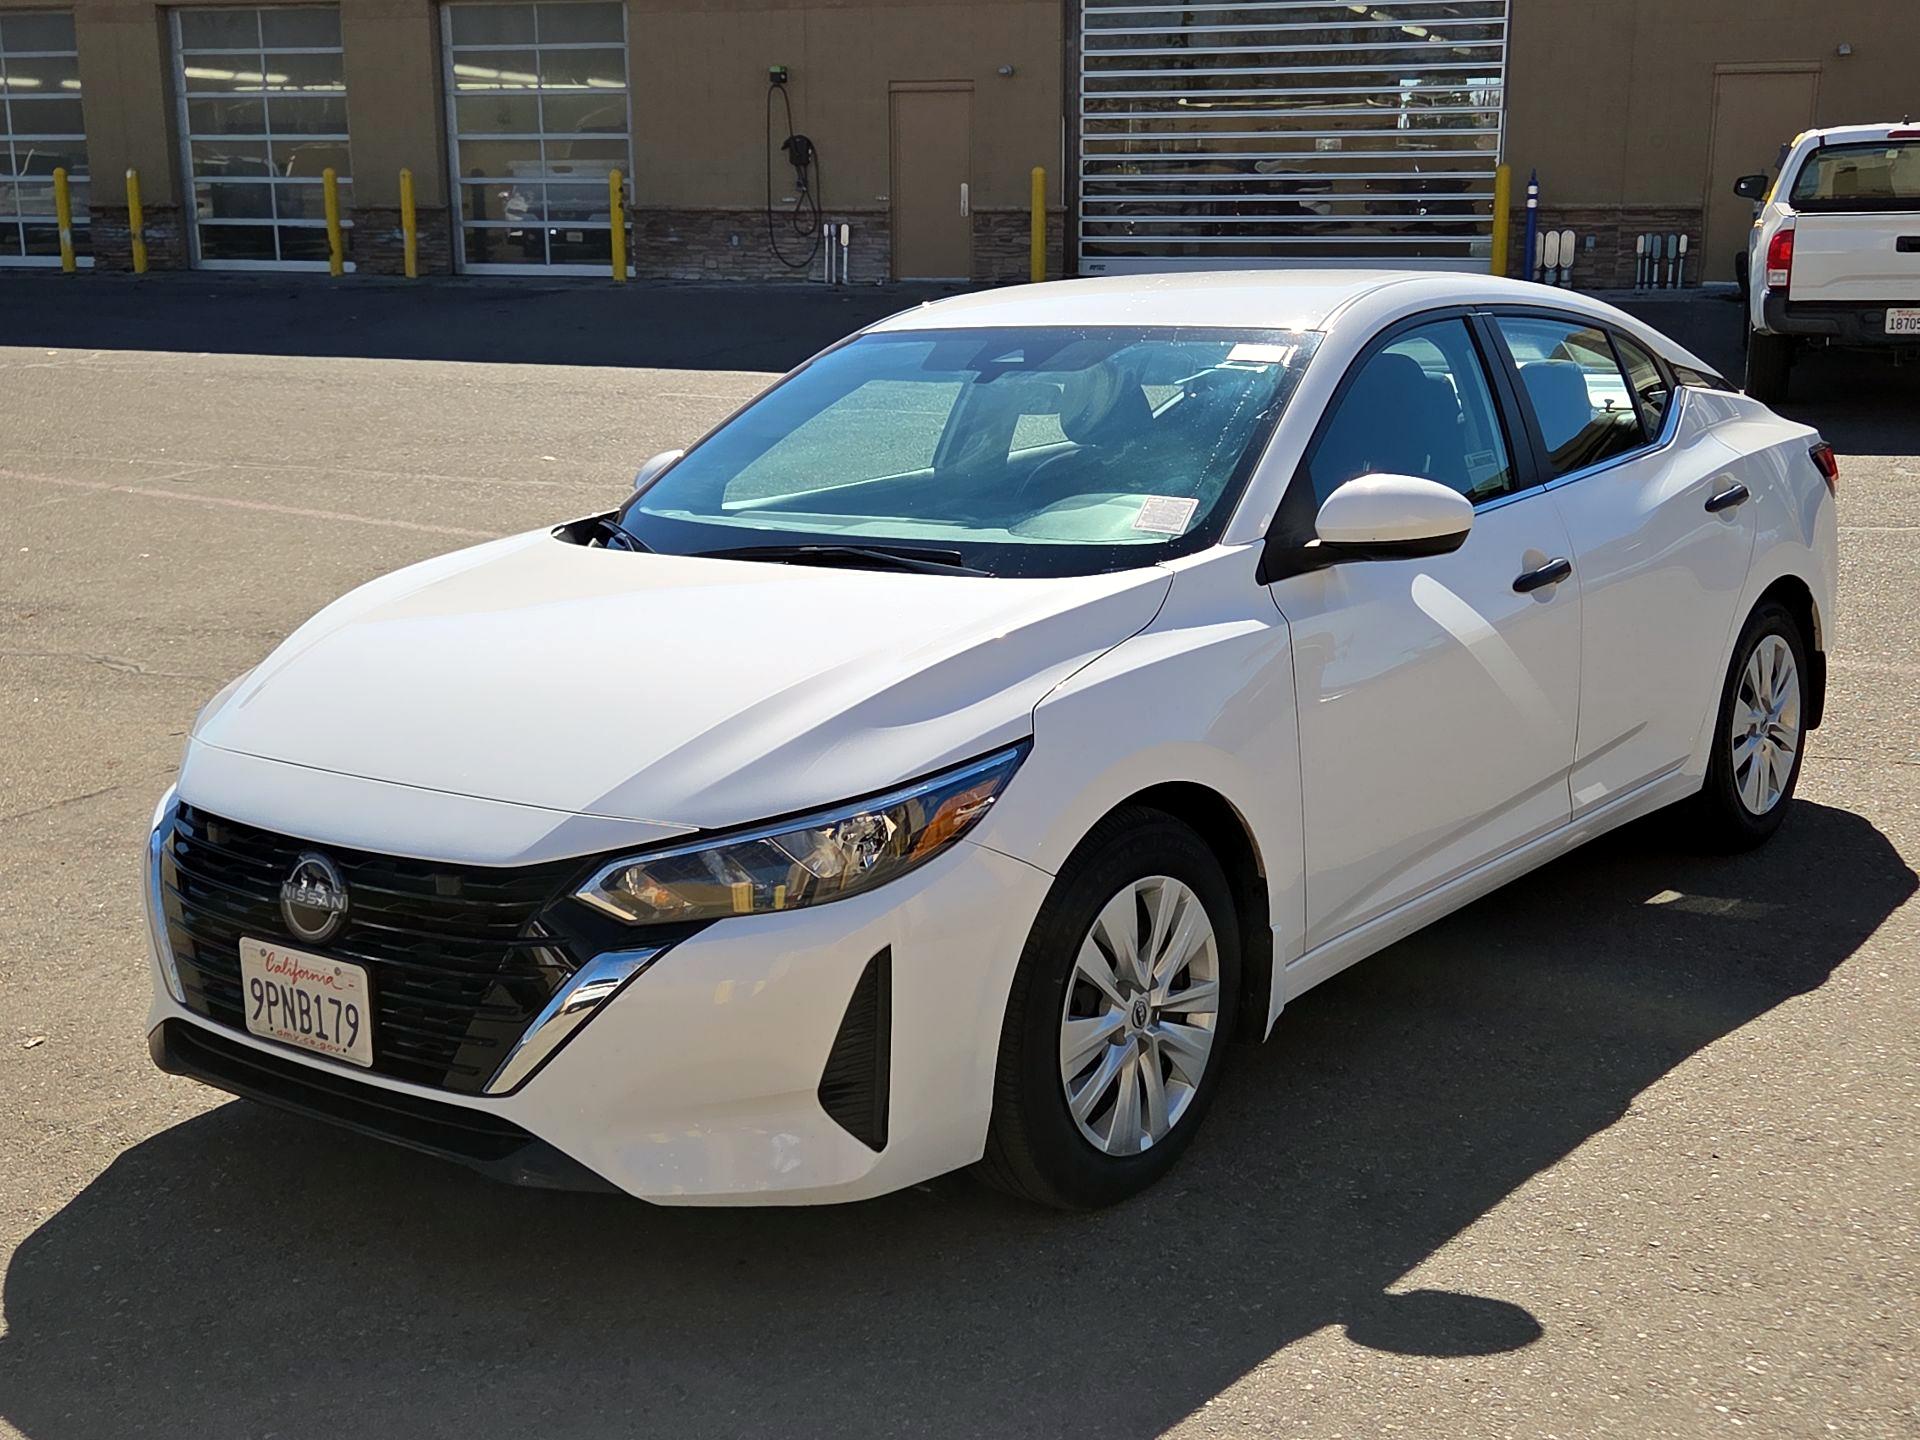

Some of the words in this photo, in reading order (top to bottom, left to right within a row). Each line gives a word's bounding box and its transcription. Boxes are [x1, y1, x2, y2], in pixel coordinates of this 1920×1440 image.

[281, 881, 344, 910] NISSAN
[265, 951, 343, 990] California
[250, 977, 359, 1048] 9PNB179
